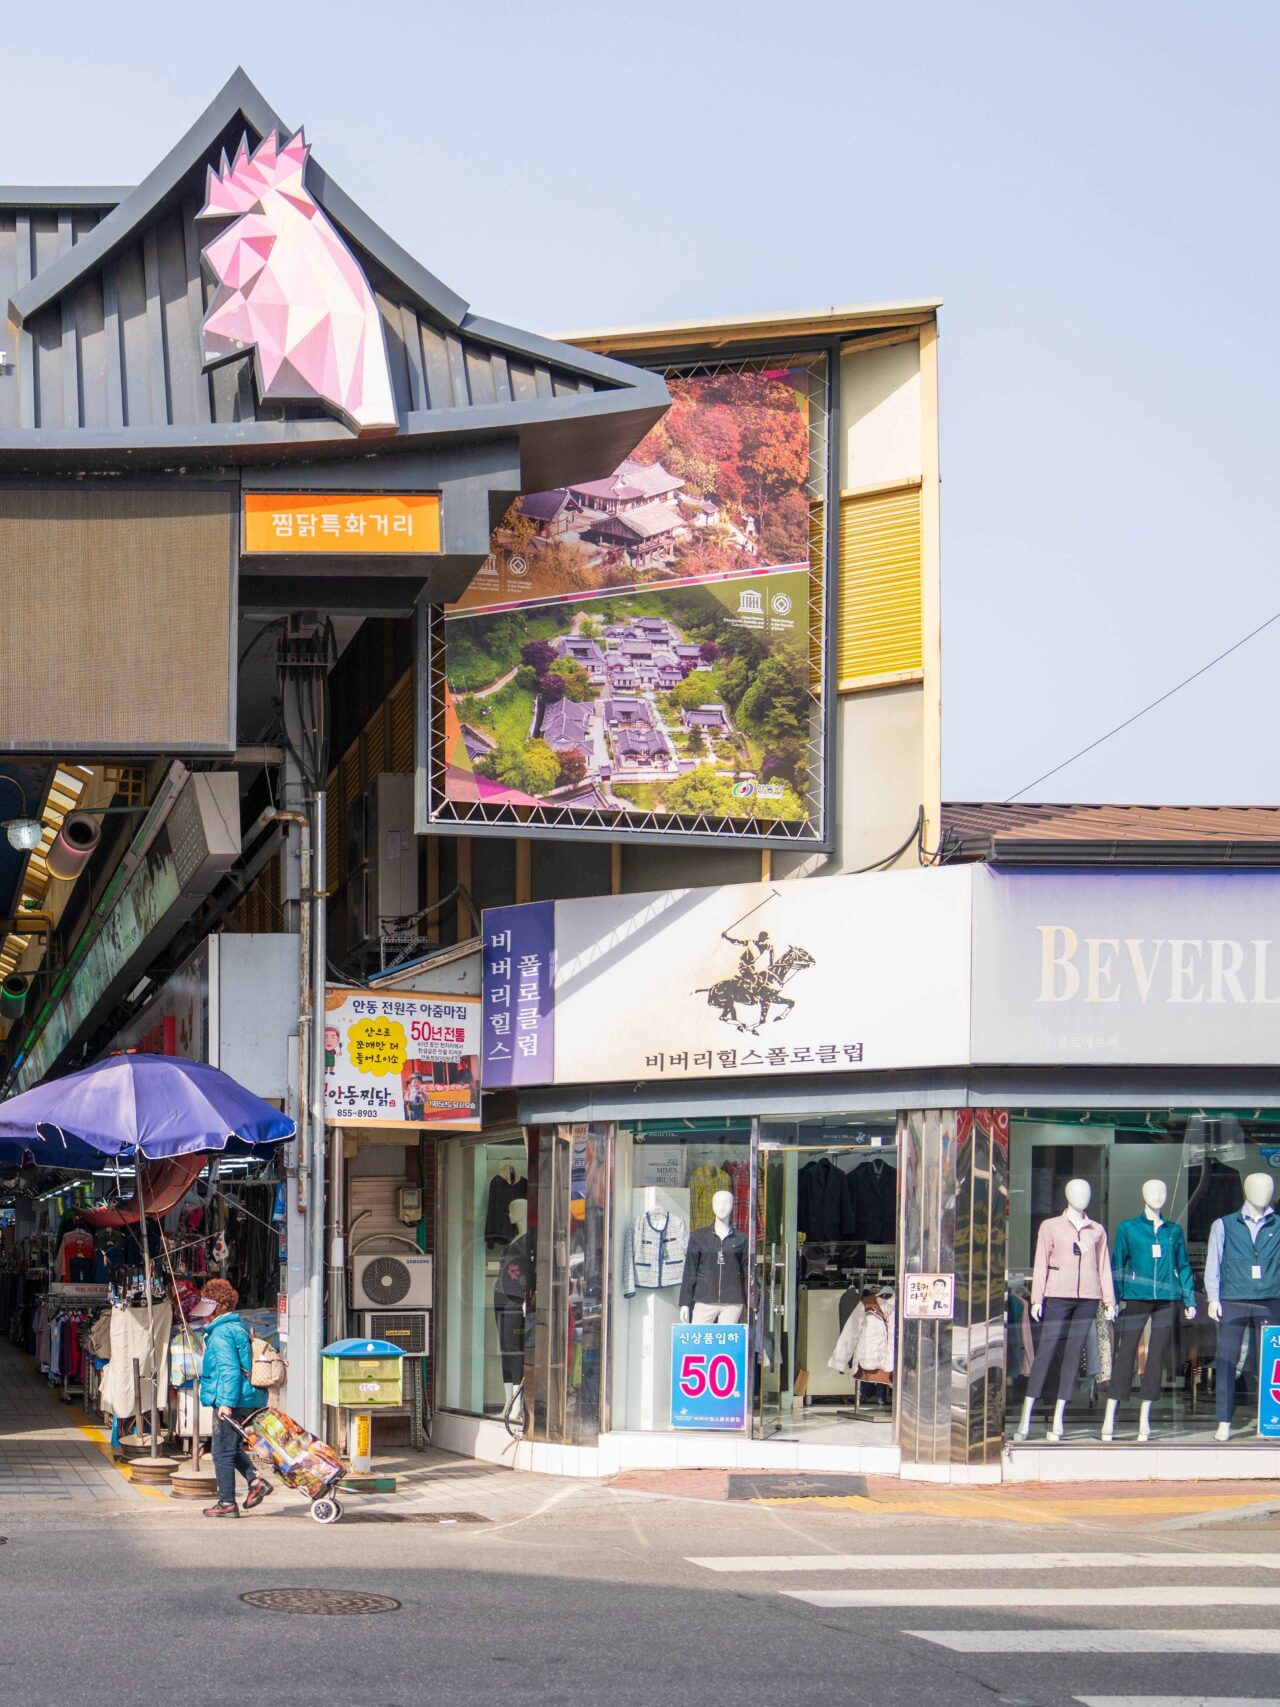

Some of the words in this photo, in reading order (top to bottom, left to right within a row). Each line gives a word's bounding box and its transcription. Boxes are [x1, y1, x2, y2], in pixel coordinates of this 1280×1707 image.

[271, 512, 414, 538] 찜닭특화거리
[488, 930, 513, 1062] 비버리힐스
[516, 953, 543, 1058] 폴로클럽
[352, 1000, 378, 1016] 안동
[381, 1001, 418, 1017] 전원주
[420, 1003, 468, 1020] 아줌마집
[364, 1027, 392, 1037] 안으로
[410, 1020, 442, 1042] 50년
[444, 1026, 466, 1043] 전통
[644, 1042, 865, 1073] 비버리힐스폴로클럽
[336, 1109, 378, 1118] 855-8903
[679, 1332, 740, 1345] 신상품입하
